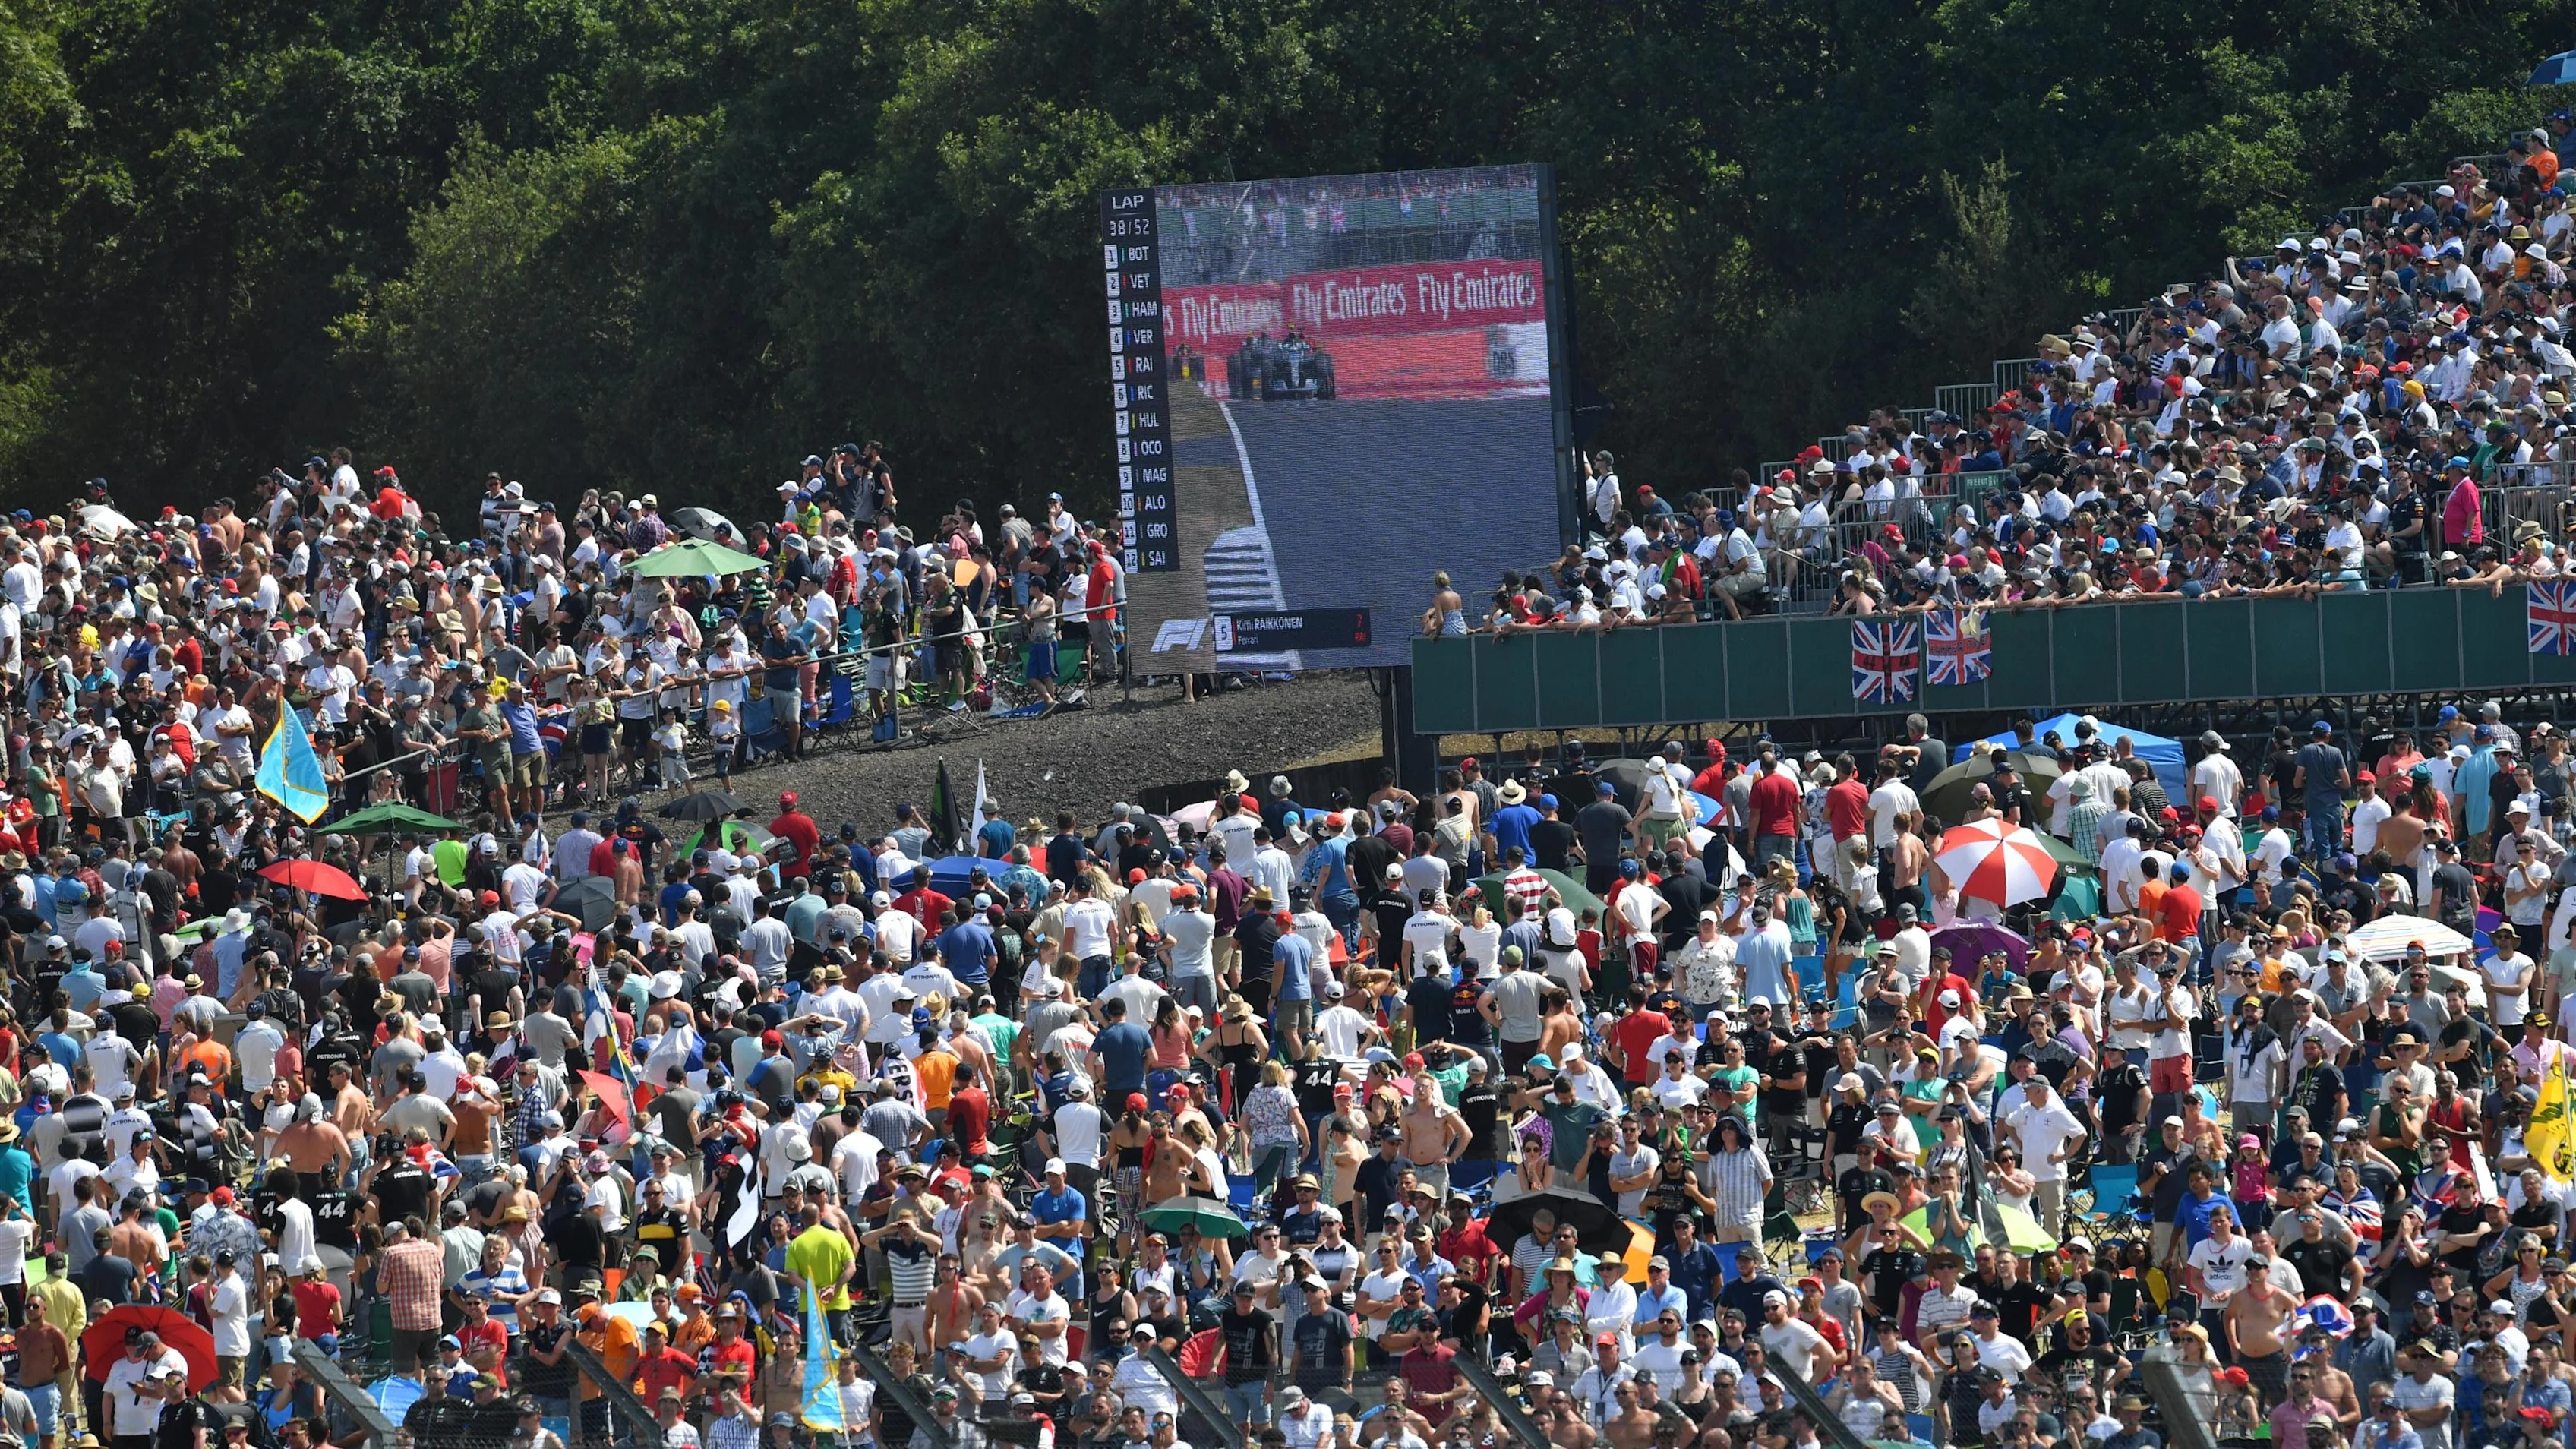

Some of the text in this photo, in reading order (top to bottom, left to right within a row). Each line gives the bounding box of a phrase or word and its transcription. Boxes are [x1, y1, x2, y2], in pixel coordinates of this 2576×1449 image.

[1112, 195, 1144, 209] LAP
[1110, 219, 1150, 236] 38/52
[1109, 246, 1149, 262] 1 BOT
[1111, 273, 1151, 289] 2 VET
[1112, 301, 1157, 317] 3 HAM
[1181, 296, 1208, 345] Fly
[1293, 283, 1322, 331] Fly
[1324, 274, 1407, 320] Emirates
[1416, 273, 1449, 320] Fly
[1453, 267, 1536, 311] Emirates
[1114, 329, 1154, 345] 4 VER
[1116, 355, 1154, 374] 5 RAI
[1118, 385, 1154, 401] 6 RIC
[1120, 412, 1160, 429] 7 HUL
[1122, 440, 1162, 456] 8 OCO
[1123, 467, 1167, 483] 9 MAG
[1123, 495, 1166, 510] 10 ALO
[1125, 523, 1168, 538] 11 GRO
[1126, 551, 1166, 567] 12 SAI
[700, 607, 720, 628] 44
[1236, 618, 1254, 632] Kimi
[1221, 626, 1227, 641] 5
[1238, 636, 1259, 646] Ferrari
[1224, 826, 1253, 834] PETRONAS
[241, 857, 257, 871] 44
[769, 895, 795, 908] PETRONAS
[1378, 900, 1406, 908] PETRONAS
[826, 909, 863, 927] HAMILTON
[1305, 1069, 1332, 1087] 44
[1466, 1094, 1497, 1103] PETRONAS
[110, 1117, 140, 1126] PETRONAS
[393, 1169, 423, 1179] PETRONAS
[262, 1201, 275, 1217] 4
[318, 1201, 346, 1218] 44
